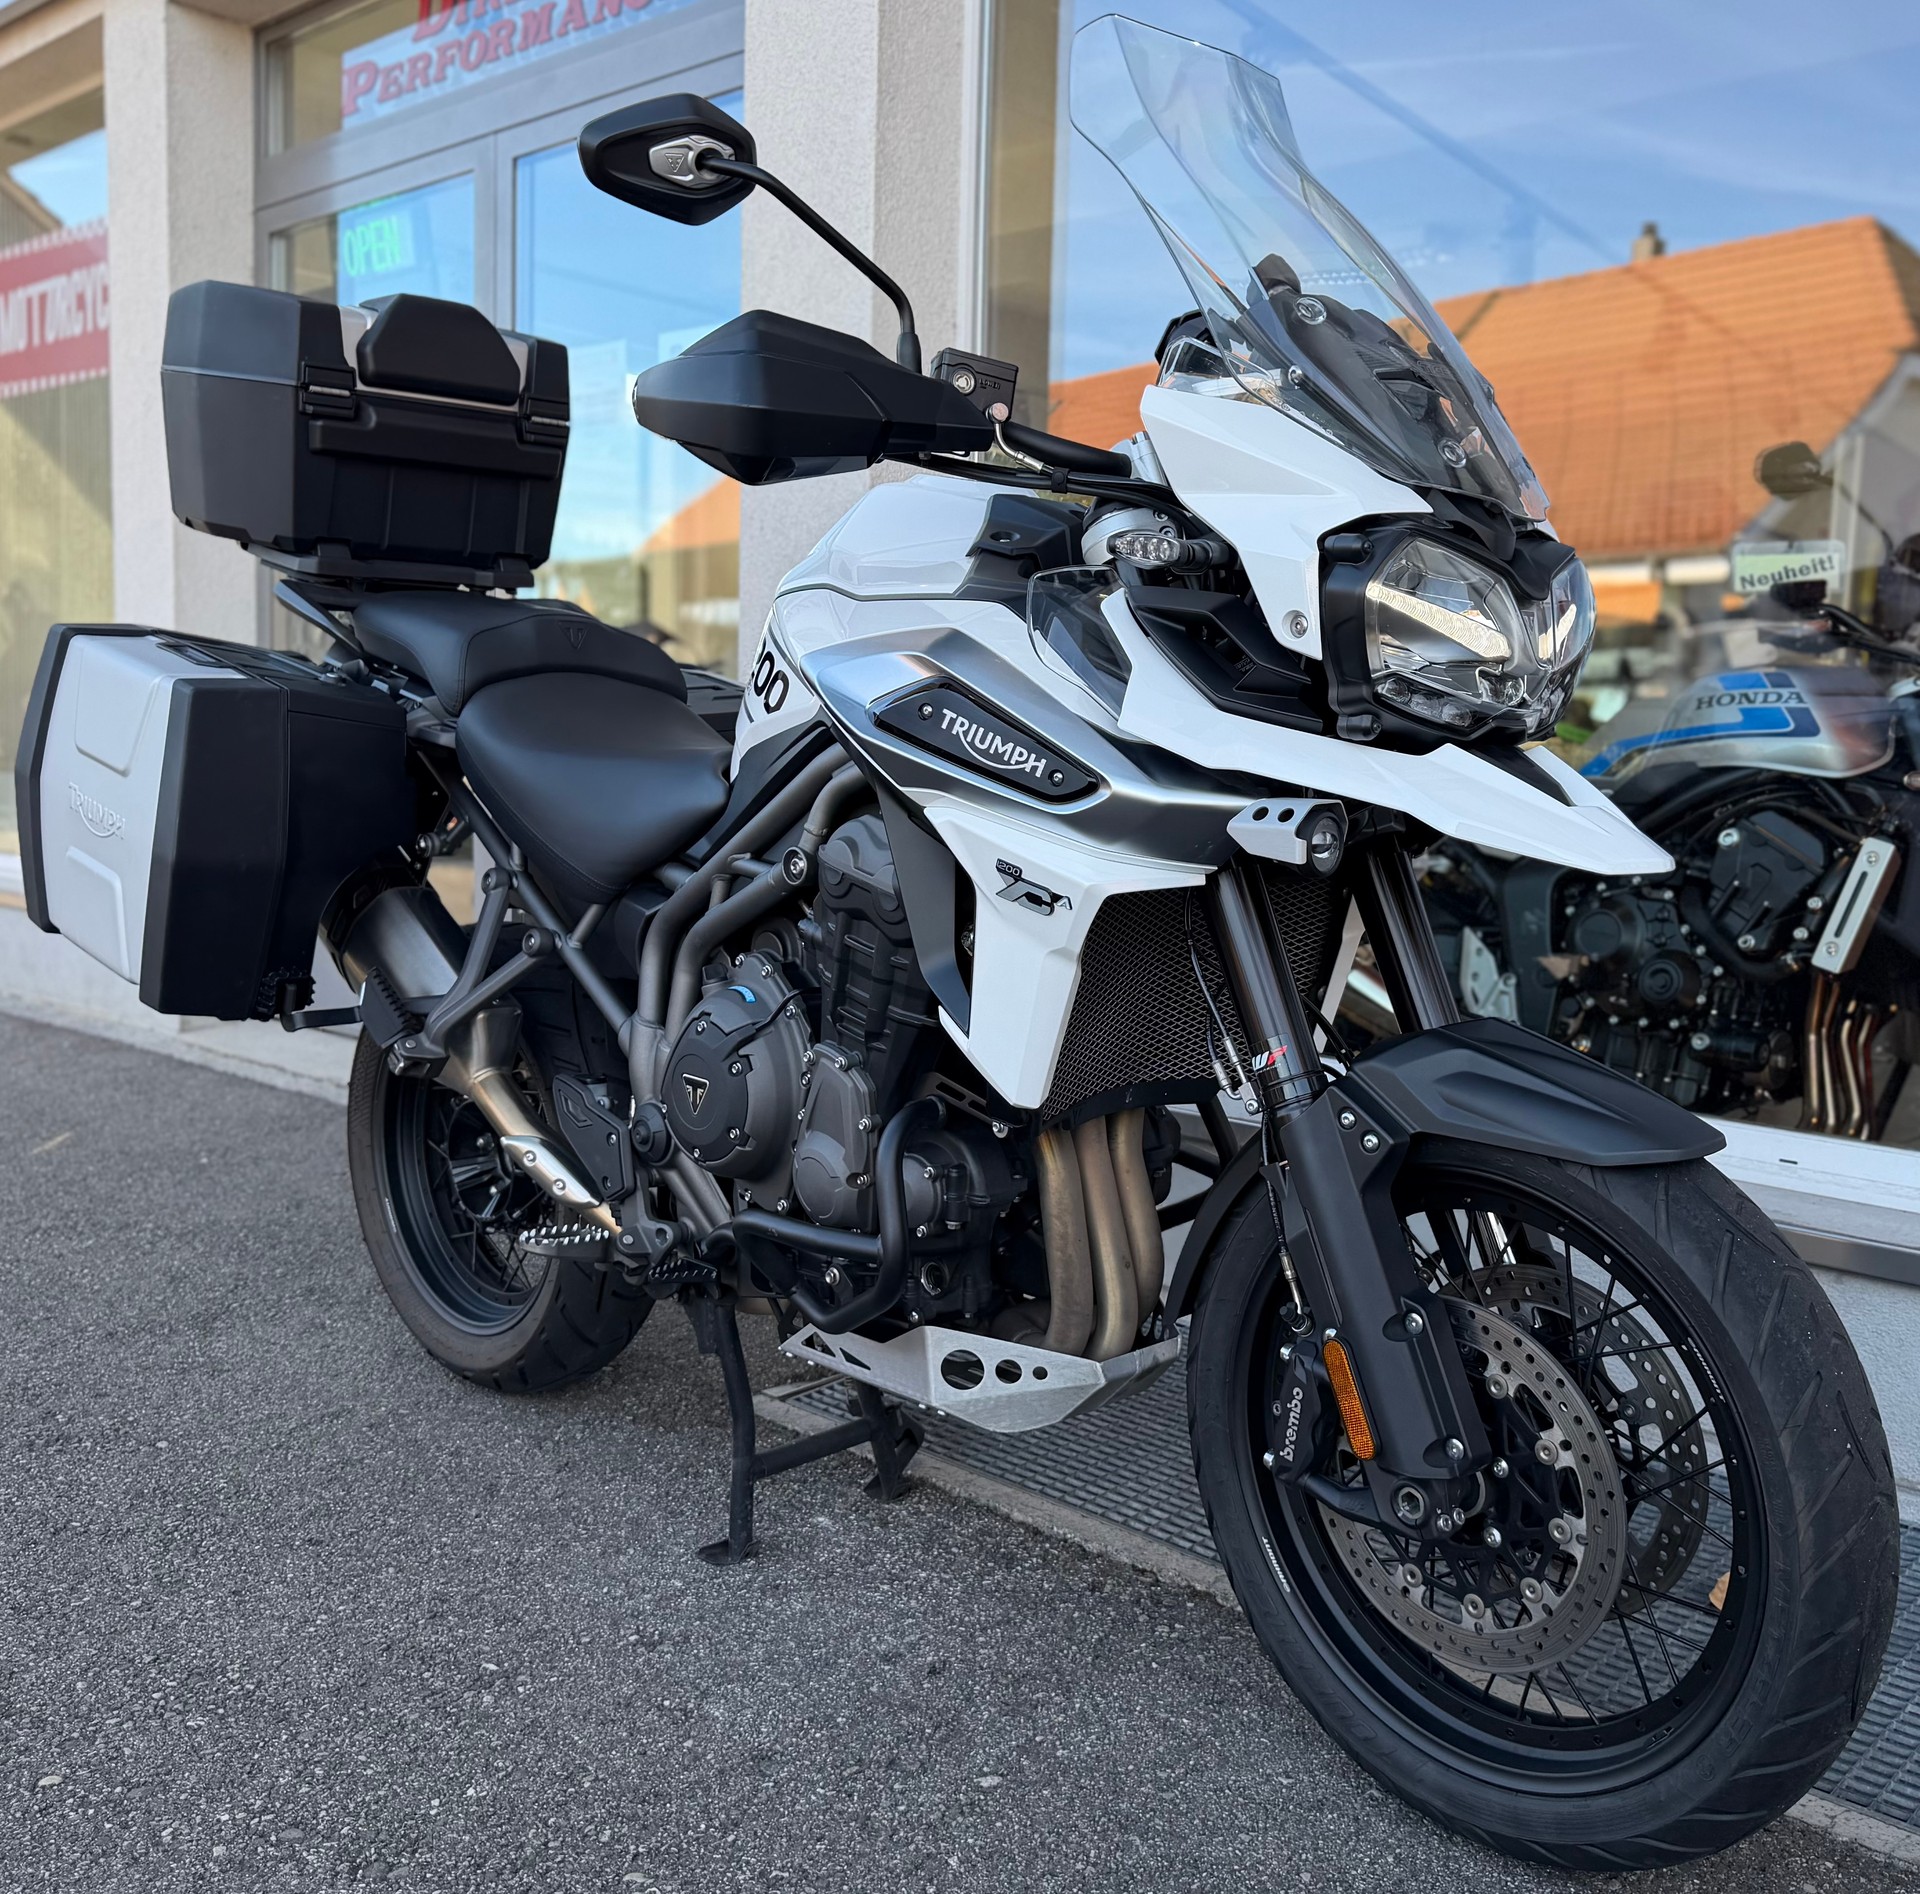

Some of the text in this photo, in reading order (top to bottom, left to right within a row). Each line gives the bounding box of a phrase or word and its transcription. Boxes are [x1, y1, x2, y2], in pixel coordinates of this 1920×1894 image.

[341, 0, 651, 118] PERFORMAN
[343, 214, 401, 278] OPEN
[1740, 555, 1835, 590] Neuheit!
[1695, 689, 1809, 711] HONDA
[940, 708, 1047, 778] TRIUMPH
[68, 781, 125, 840] TRIUMPH
[996, 860, 1021, 878] 1200
[1279, 1386, 1304, 1462] brembo
